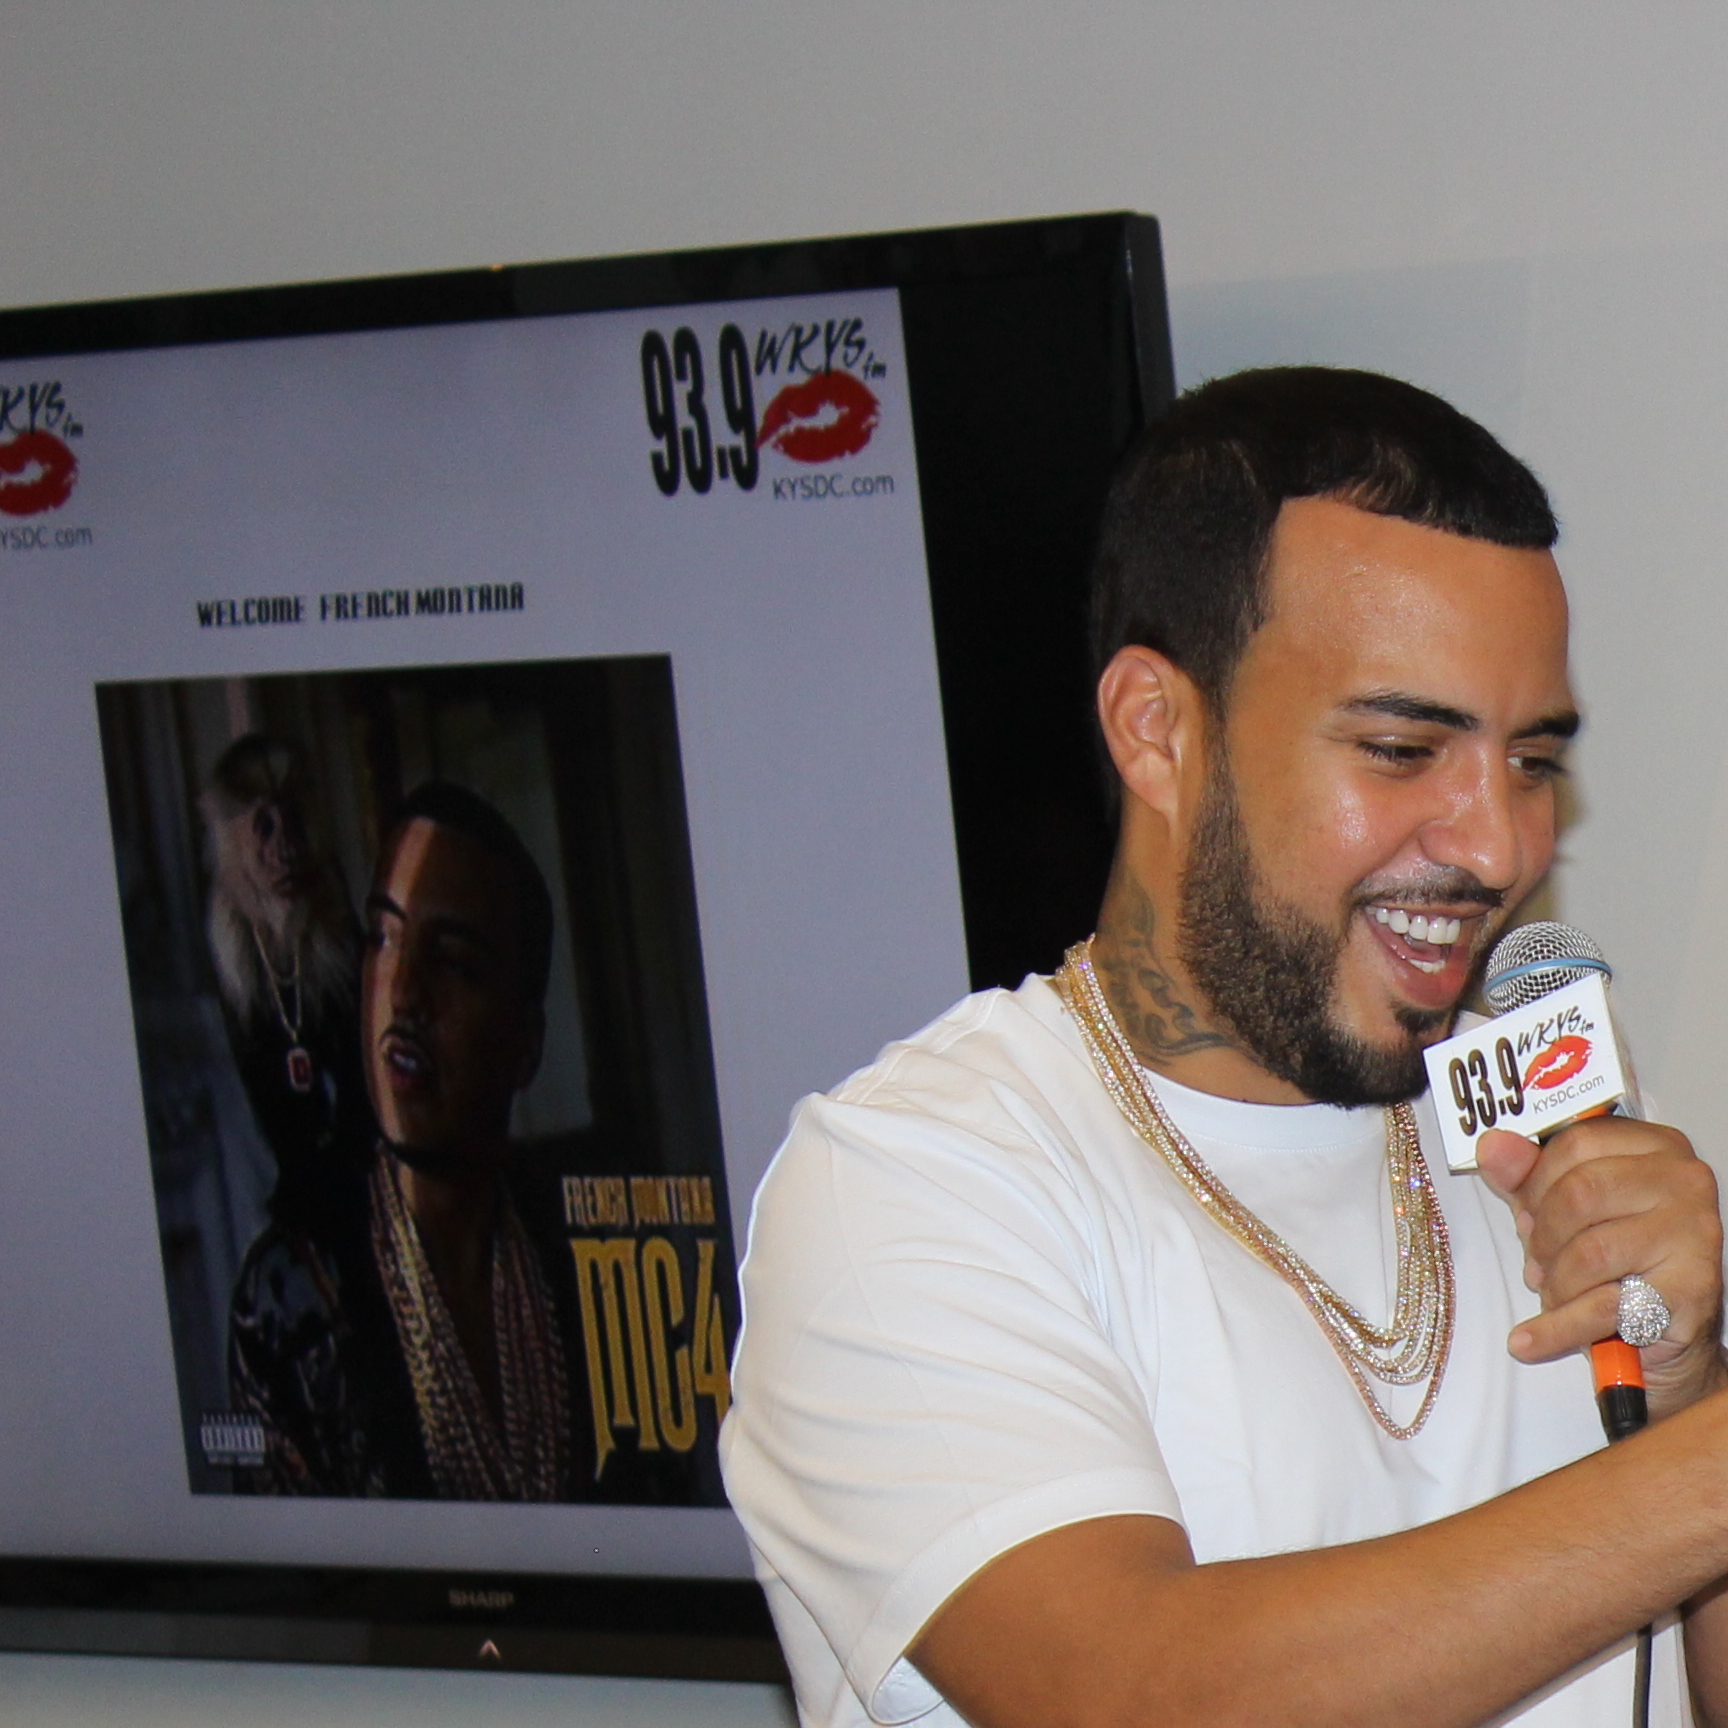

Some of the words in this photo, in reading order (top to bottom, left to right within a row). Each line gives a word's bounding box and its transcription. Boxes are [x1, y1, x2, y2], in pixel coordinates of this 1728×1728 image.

[640, 322, 760, 497] 93.9
[755, 316, 867, 378] WKYS
[772, 473, 895, 500] KYSDC.com
[196, 594, 306, 628] WELCOME
[319, 589, 411, 622] FRENCH
[414, 580, 525, 616] MONTANA
[1448, 1036, 1525, 1137] 93.9
[1517, 1004, 1583, 1057] WKYS
[1532, 1073, 1605, 1115] KYSDC.com
[568, 1236, 733, 1482] MC4
